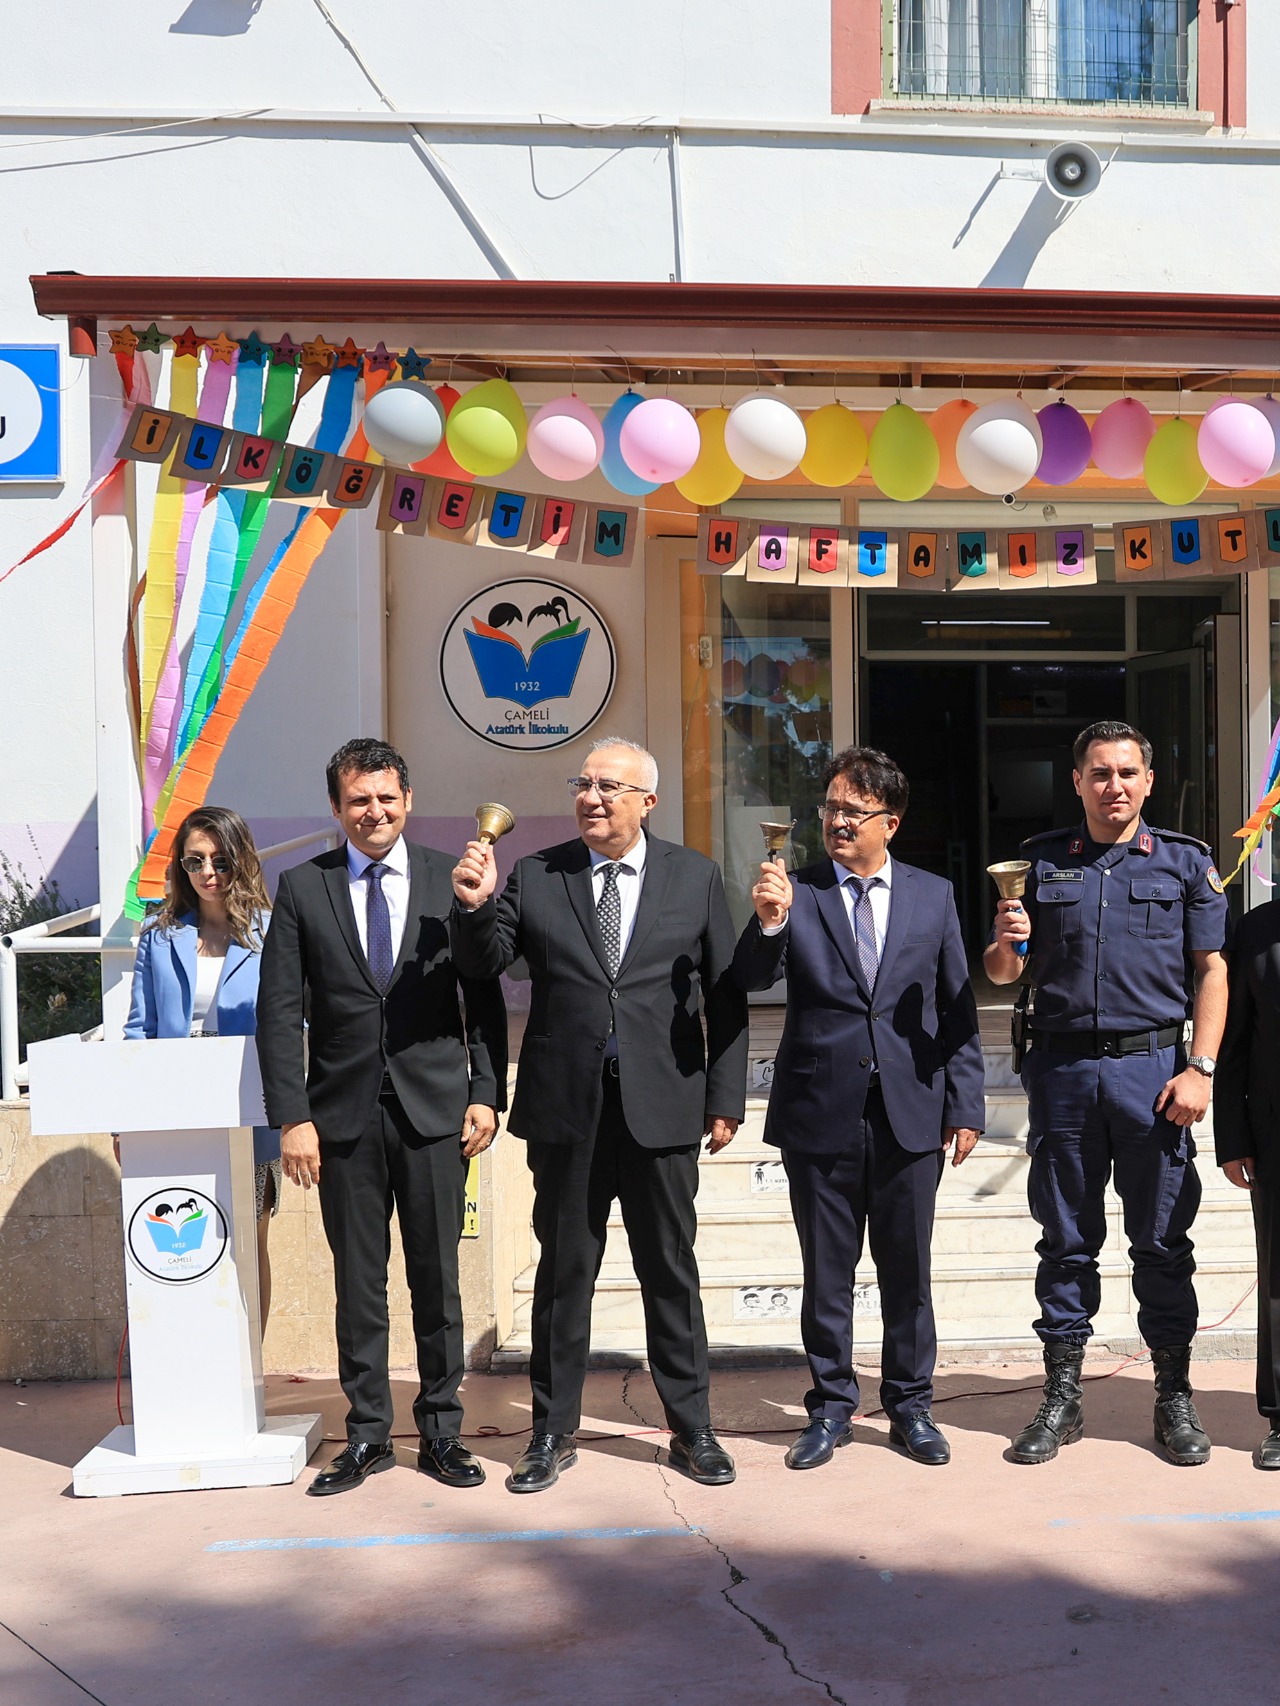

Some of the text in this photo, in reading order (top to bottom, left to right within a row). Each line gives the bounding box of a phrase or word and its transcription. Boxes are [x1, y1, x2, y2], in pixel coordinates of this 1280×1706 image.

[715, 531, 1079, 568] HAFTAMIZ
[515, 682, 540, 691] 1932
[504, 707, 550, 723] ÇAMELİ
[485, 721, 568, 735] Atatürk İlkokulu
